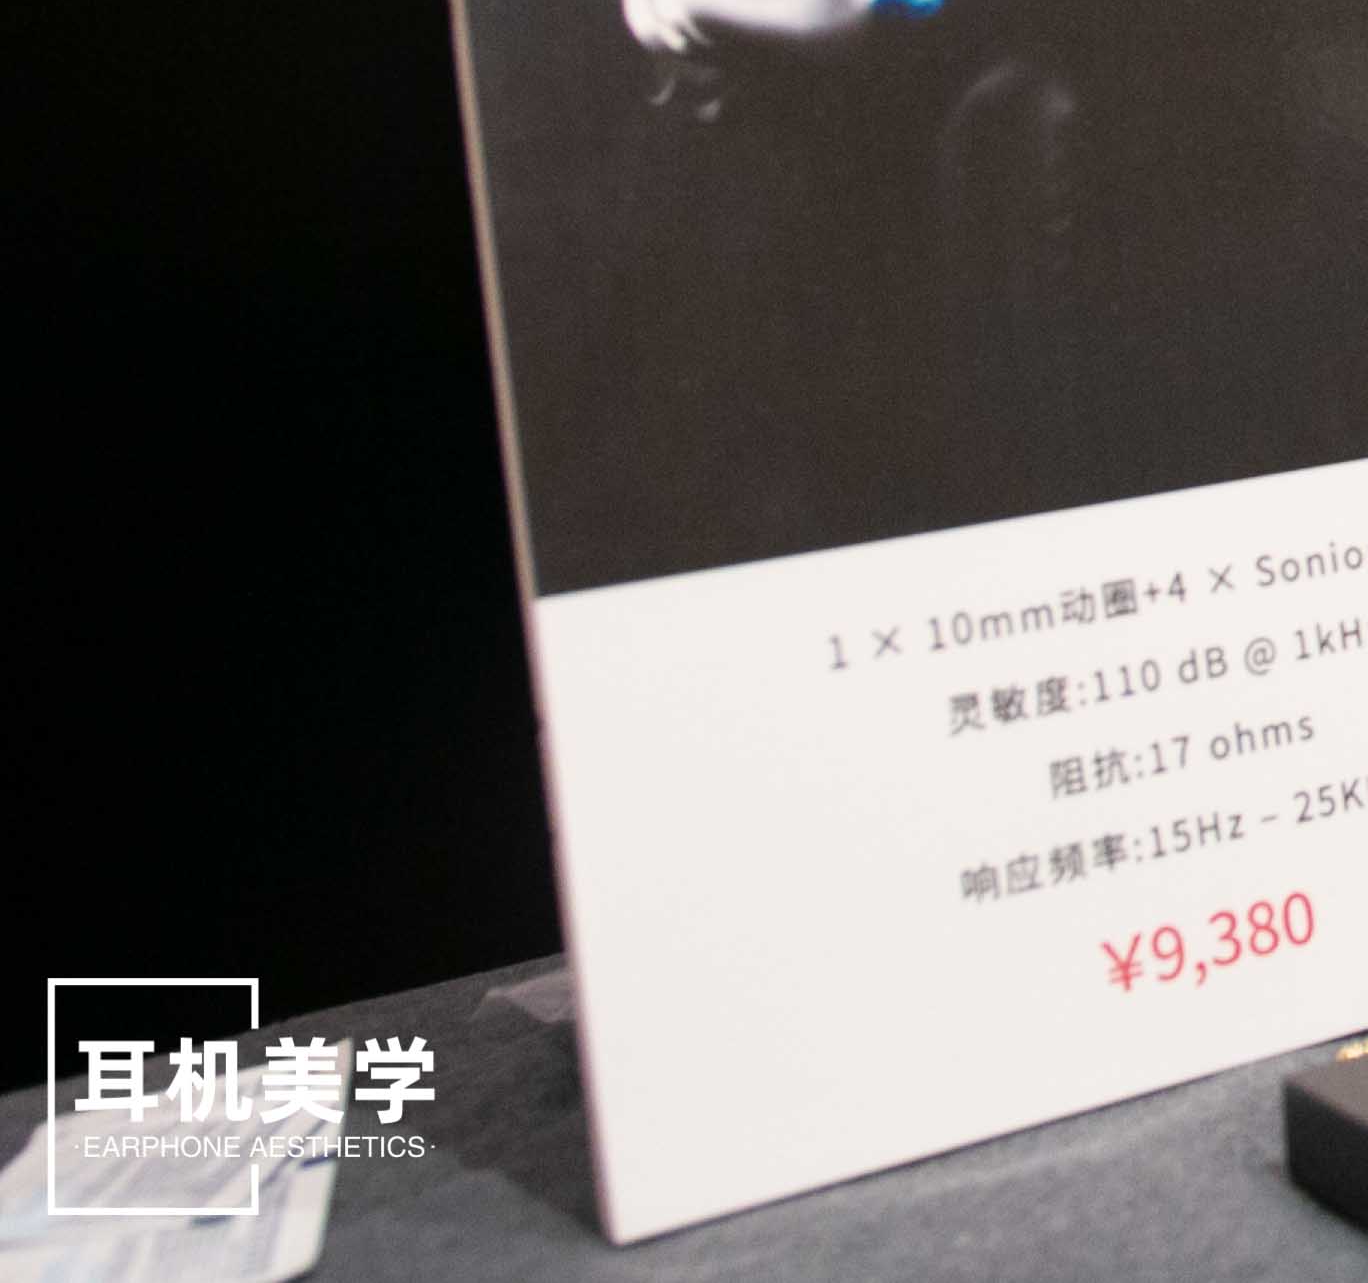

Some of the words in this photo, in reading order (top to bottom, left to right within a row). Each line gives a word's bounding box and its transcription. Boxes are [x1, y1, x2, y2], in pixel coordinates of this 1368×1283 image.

[826, 633, 848, 671] 1
[948, 658, 1162, 737] 灵敏度:110
[1179, 647, 1229, 684] dB
[1244, 635, 1278, 675] @
[1048, 735, 1191, 801] 阻抗:17
[1210, 714, 1316, 761] ohms
[960, 814, 1246, 904] 响应频率:15Hz
